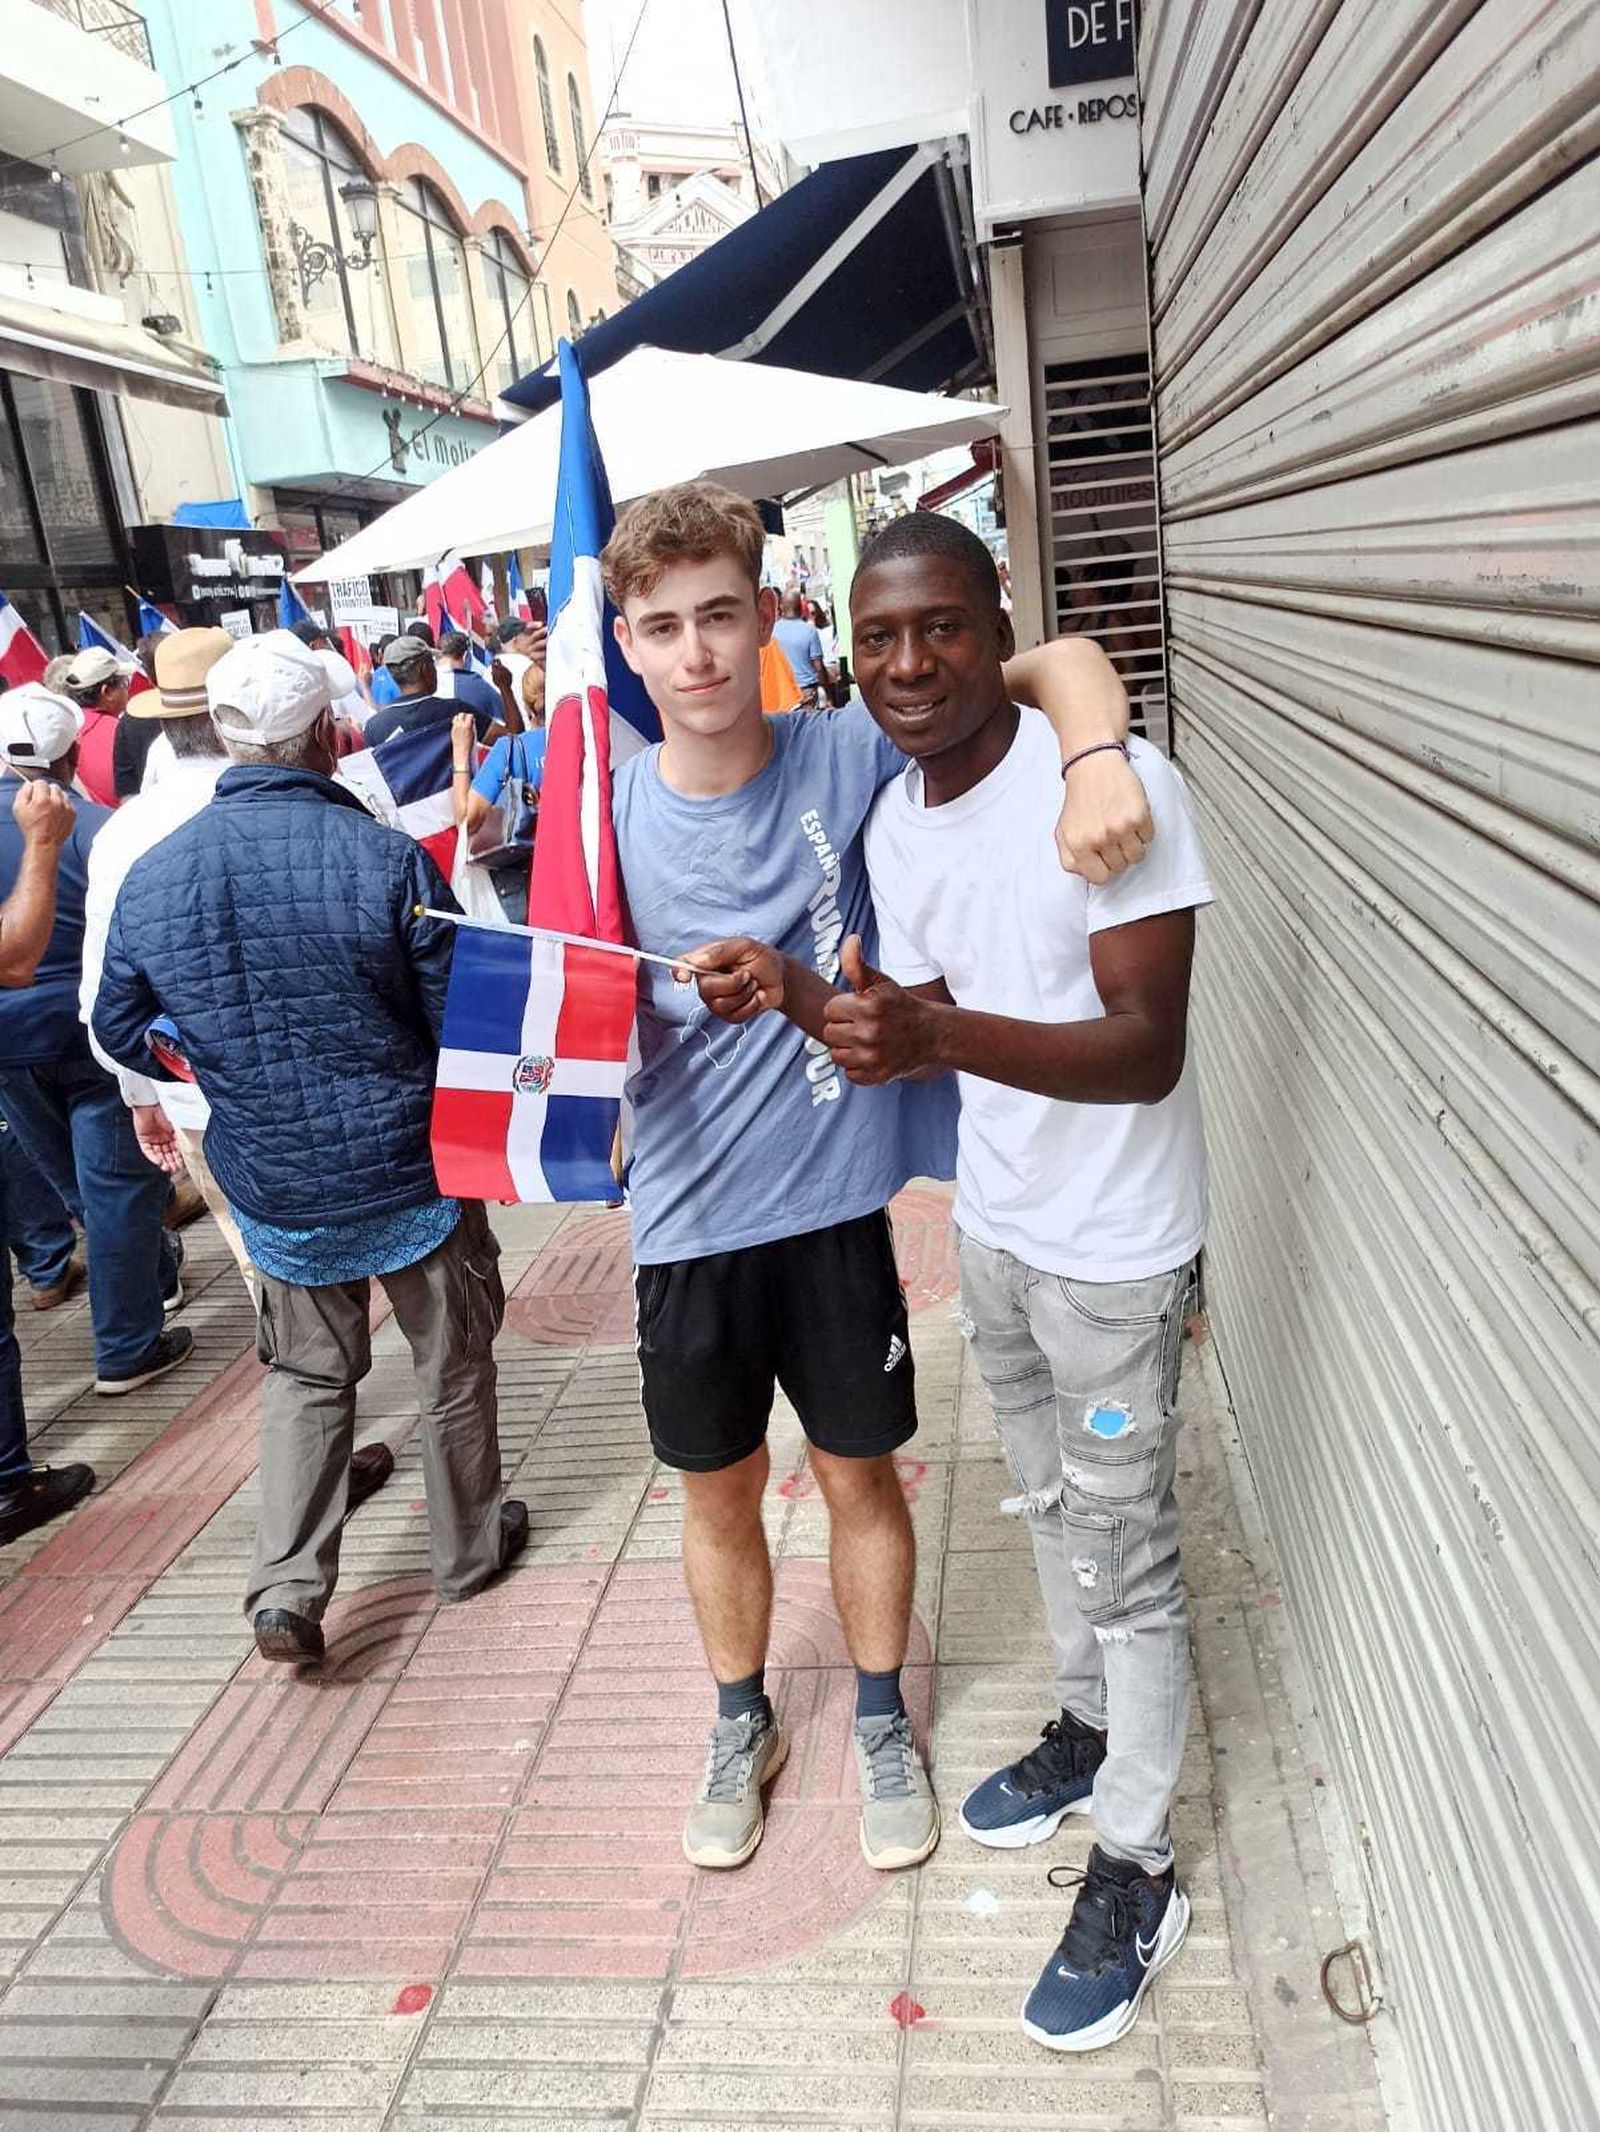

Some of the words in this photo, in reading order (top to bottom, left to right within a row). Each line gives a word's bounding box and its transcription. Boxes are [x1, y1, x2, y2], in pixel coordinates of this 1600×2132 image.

[1067, 1, 1107, 49] DE
[1009, 104, 1063, 135] CAFE
[434, 434, 478, 467] Moli
